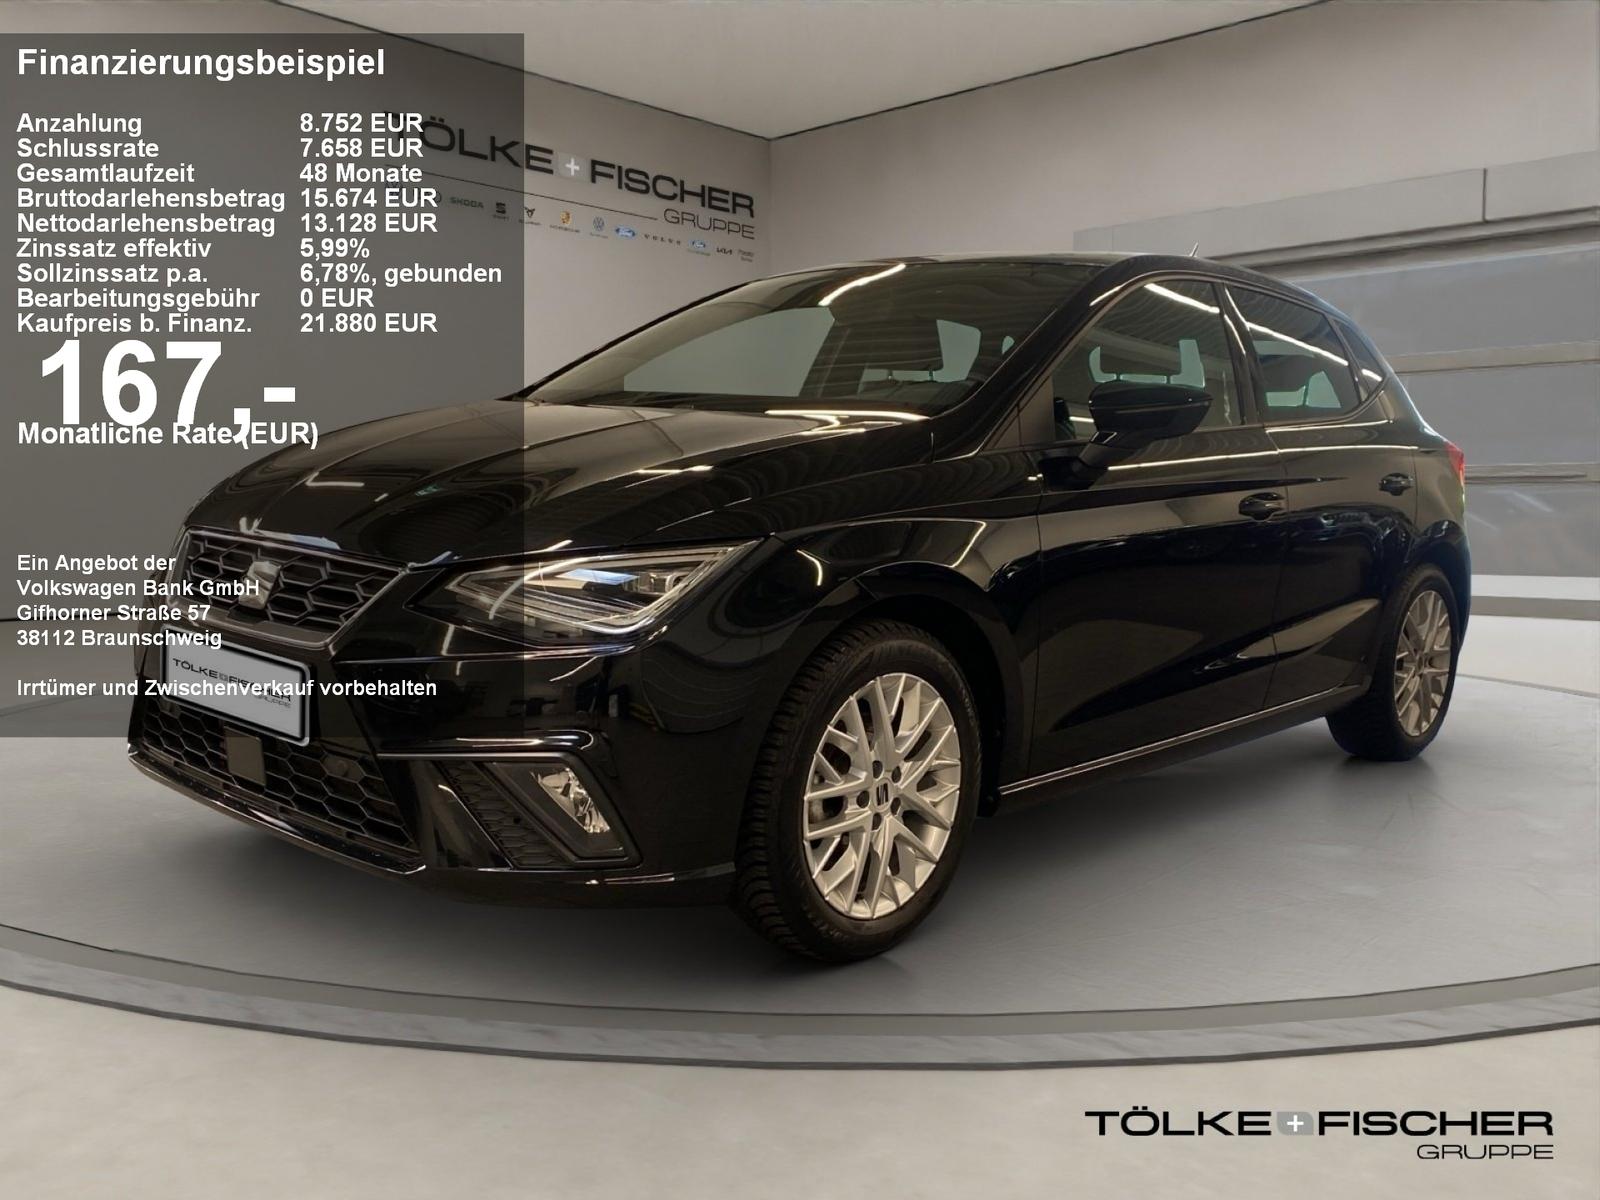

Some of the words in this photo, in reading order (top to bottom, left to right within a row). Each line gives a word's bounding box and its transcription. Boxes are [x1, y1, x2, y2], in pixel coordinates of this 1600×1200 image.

[591, 159, 755, 218] FISCHER
[663, 207, 755, 240] GRUPPE
[172, 657, 219, 680] TÖLKE
